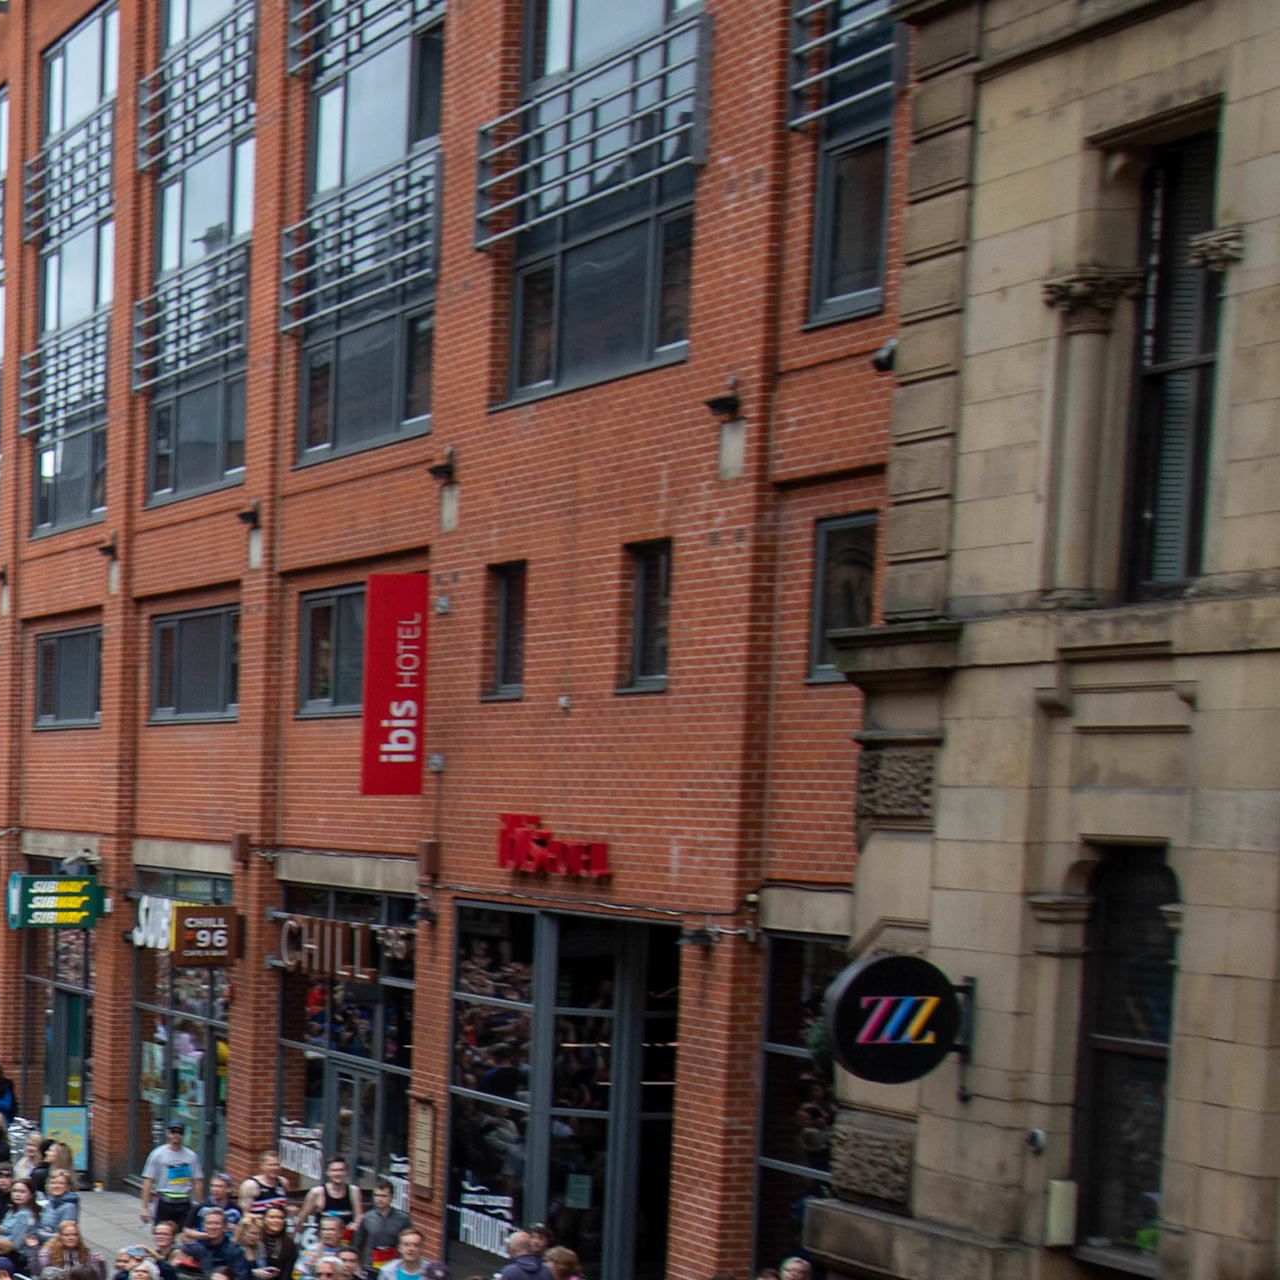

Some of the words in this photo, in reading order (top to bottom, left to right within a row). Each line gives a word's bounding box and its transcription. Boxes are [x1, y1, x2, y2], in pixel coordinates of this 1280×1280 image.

[396, 614, 421, 688] HOTEL
[380, 700, 416, 763] ibis
[28, 881, 90, 893] SUBWAY
[28, 896, 90, 909] SUBWAY
[28, 911, 90, 924] SUBWAY
[184, 917, 228, 928] CHILL
[282, 920, 379, 982] CHILL
